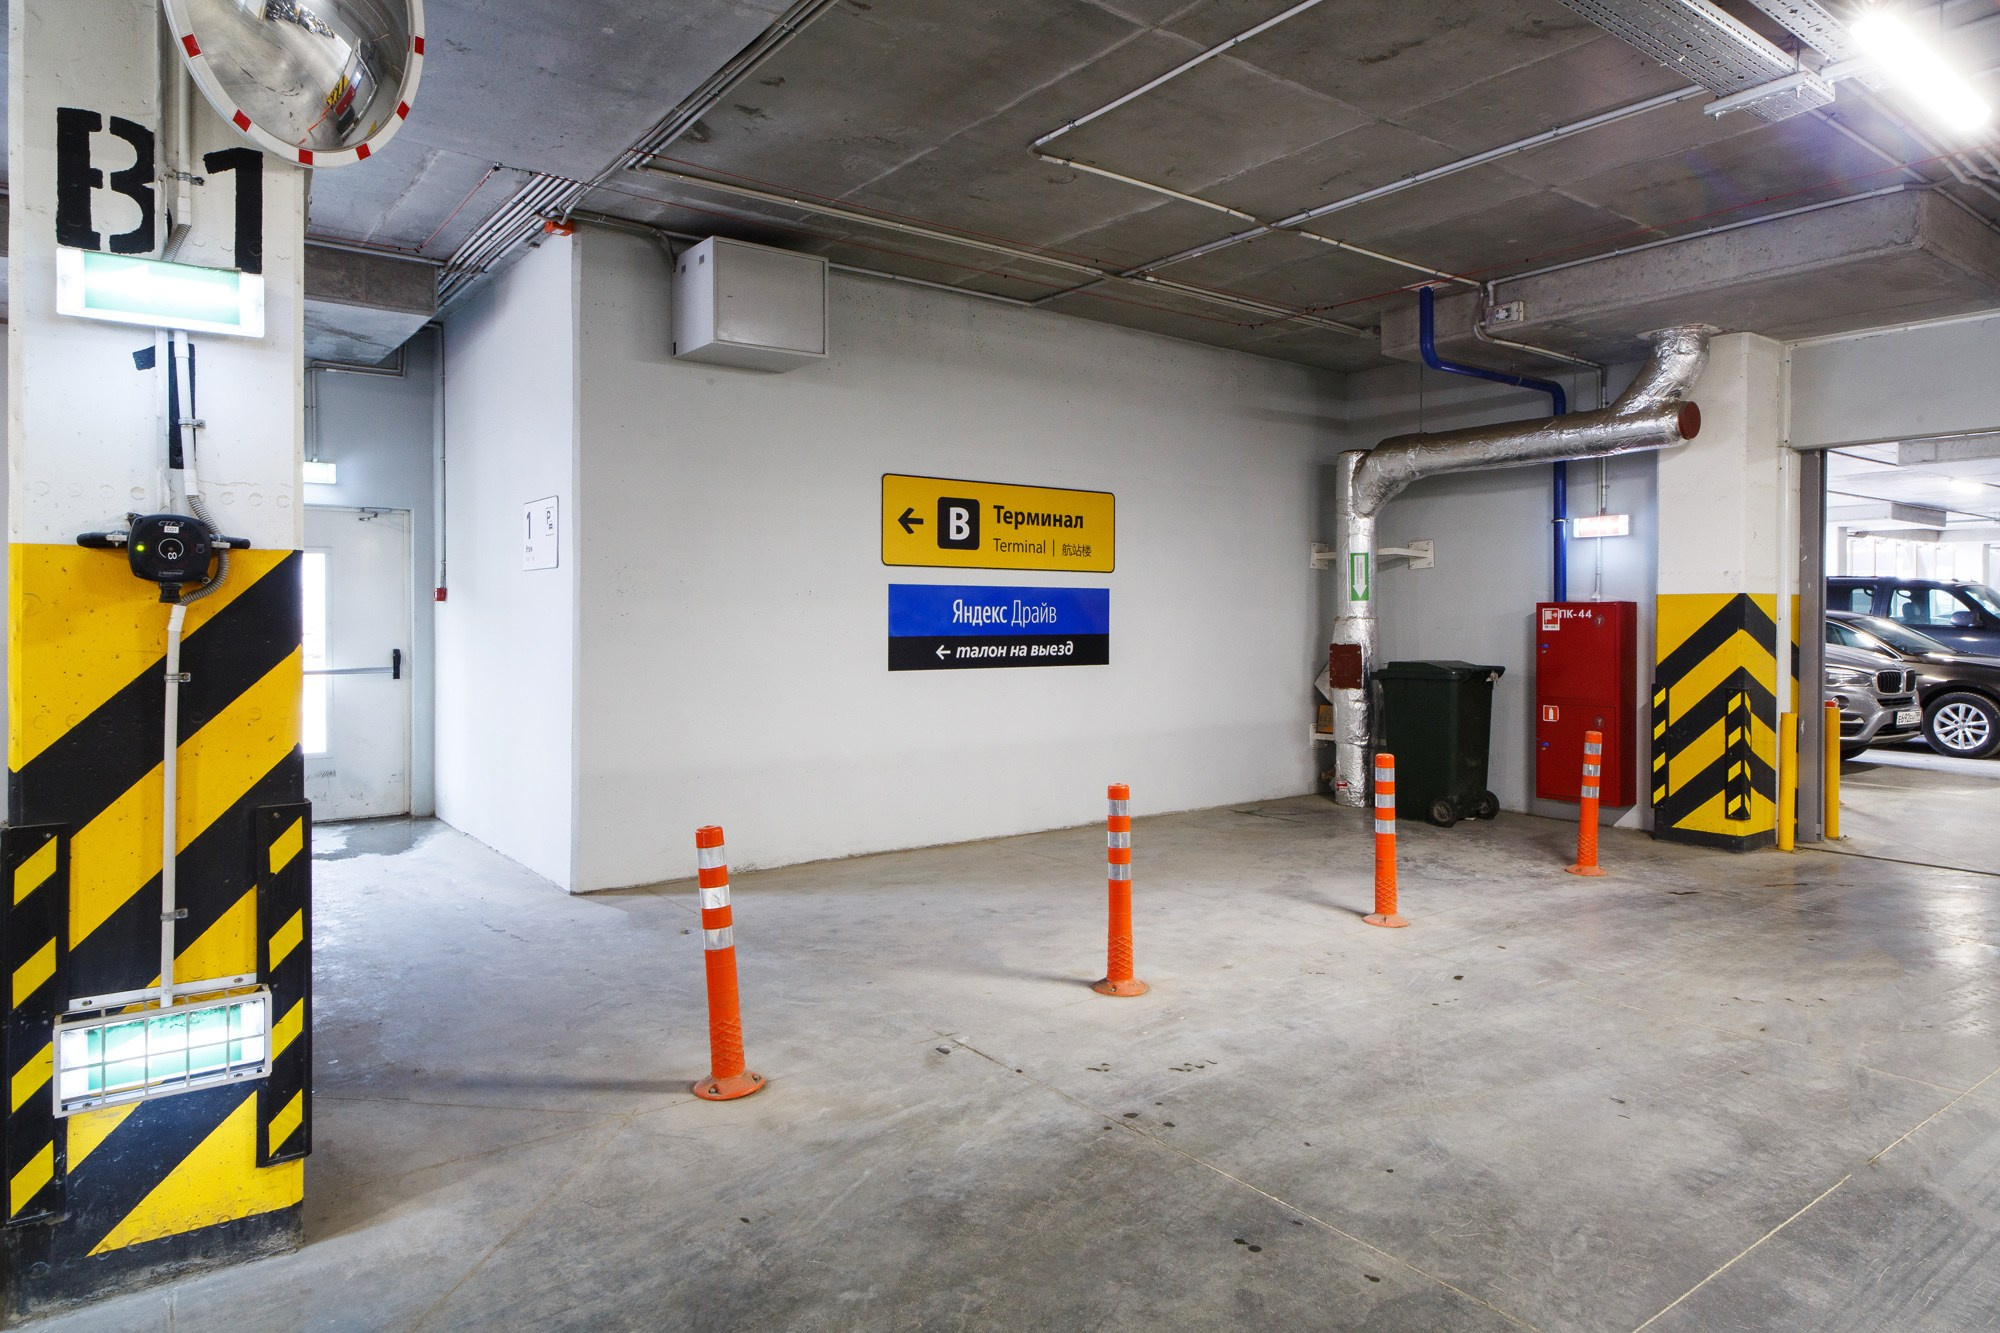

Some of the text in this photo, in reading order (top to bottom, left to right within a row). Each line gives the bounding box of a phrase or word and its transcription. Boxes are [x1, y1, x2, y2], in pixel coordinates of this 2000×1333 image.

[949, 506, 971, 541] B
[993, 505, 1084, 530] Терминал
[993, 538, 1046, 554] Terminal
[1061, 543, 1092, 558] 航站楼
[952, 599, 1057, 628] Яндекс Драйв
[1560, 609, 1592, 619] ПК-44
[956, 640, 1074, 659] талон на выезд
